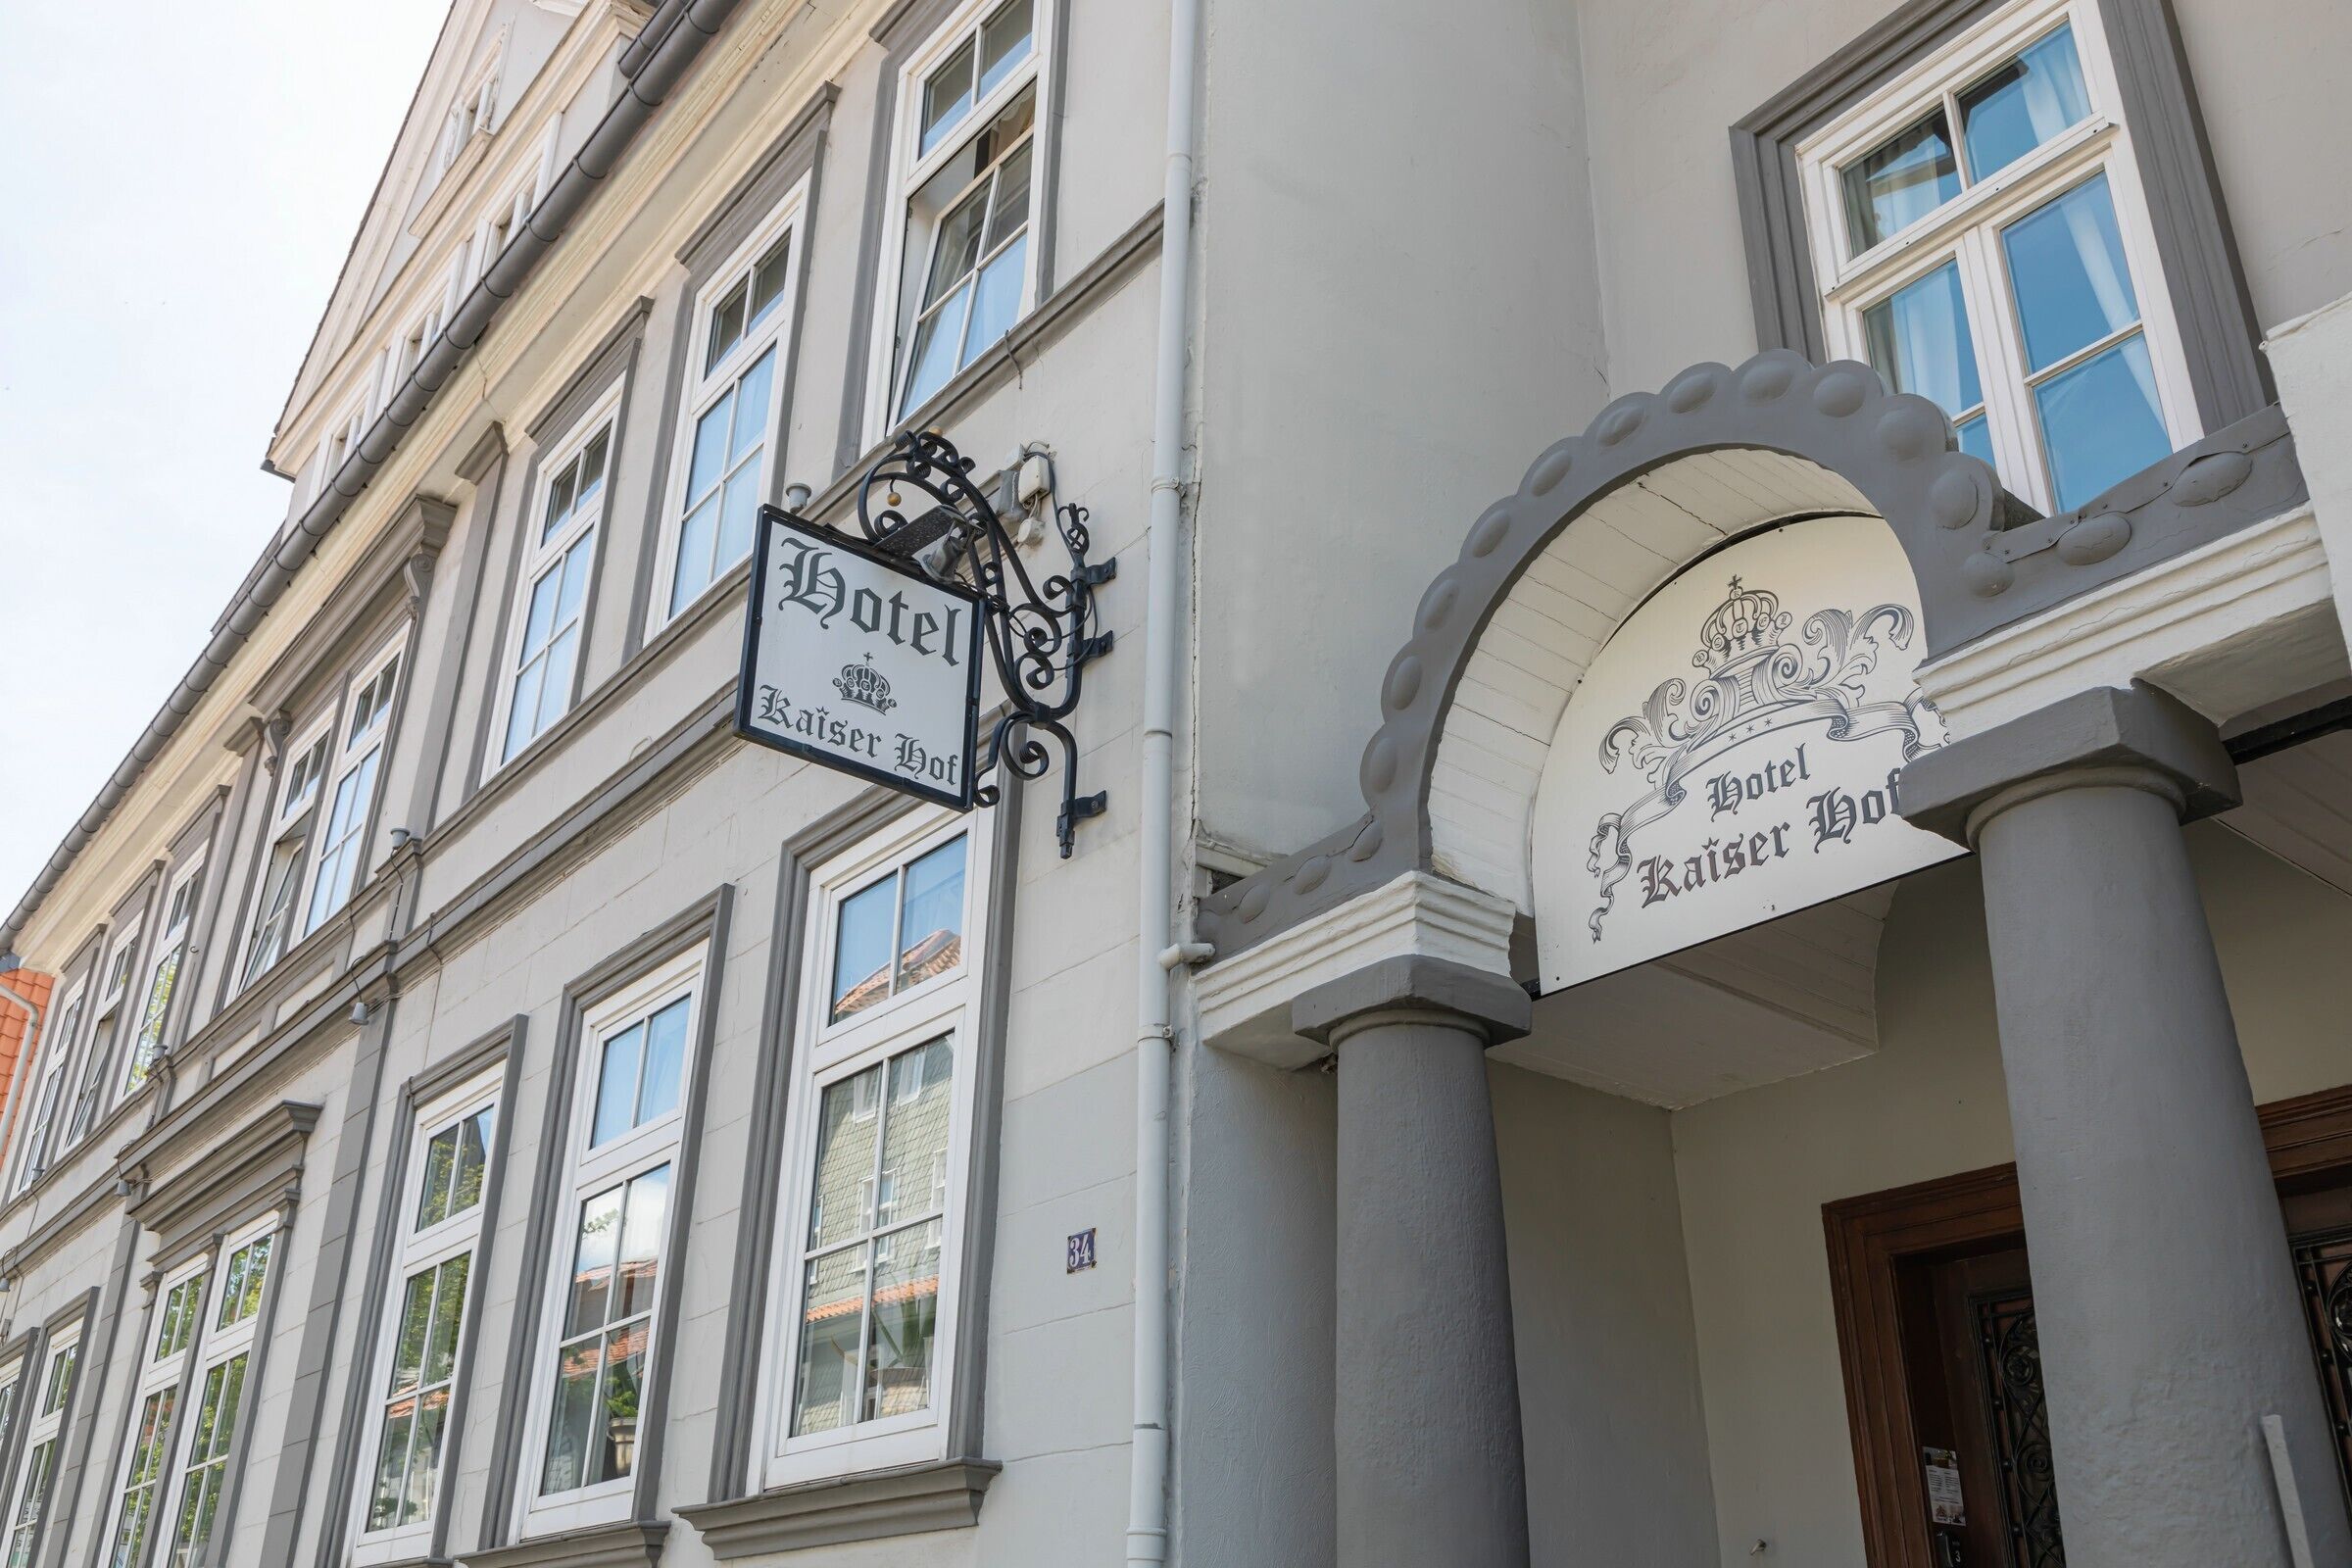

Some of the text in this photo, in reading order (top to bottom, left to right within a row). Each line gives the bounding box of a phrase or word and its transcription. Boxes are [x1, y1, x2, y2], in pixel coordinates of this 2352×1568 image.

[778, 537, 962, 666] Hotel
[758, 684, 882, 758] Kaiser
[894, 733, 958, 785] Hof
[1705, 742, 1811, 822] Hotel
[1637, 767, 1901, 908] Kaiser Hof
[1069, 1234, 1092, 1267] 34
